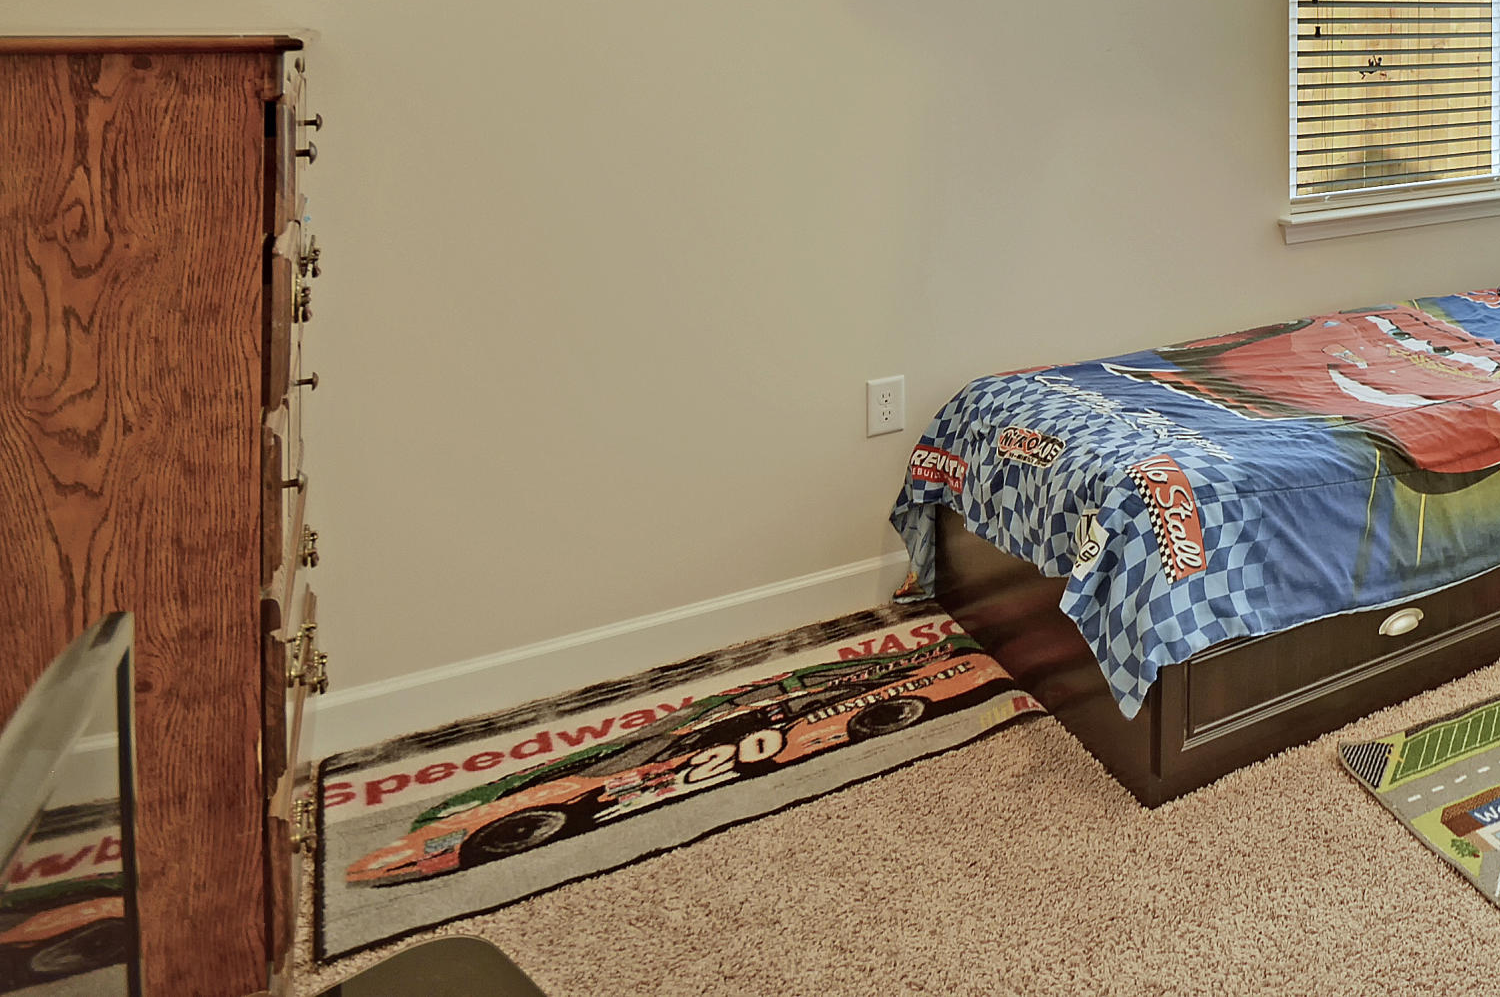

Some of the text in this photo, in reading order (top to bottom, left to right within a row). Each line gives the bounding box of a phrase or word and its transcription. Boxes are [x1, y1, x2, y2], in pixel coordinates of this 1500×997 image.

[1135, 458, 1202, 571] No Stall
[687, 729, 784, 784] 20
